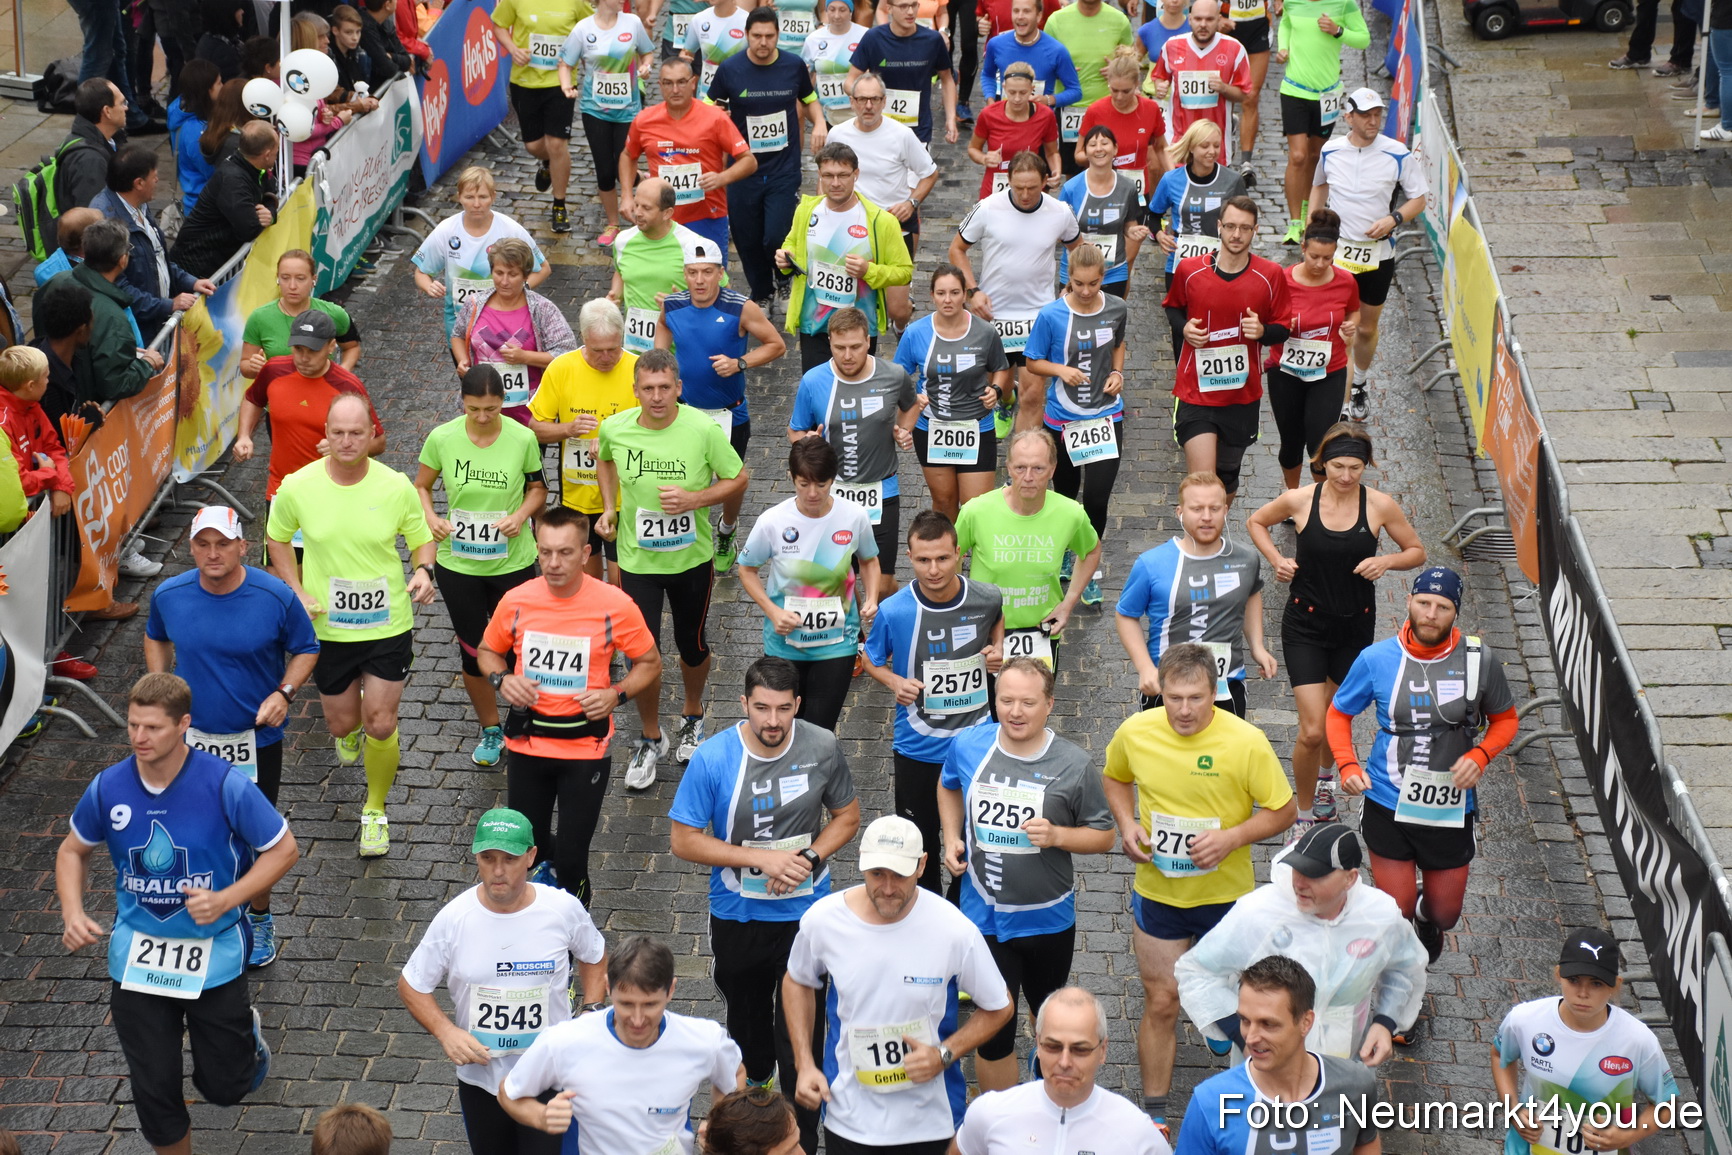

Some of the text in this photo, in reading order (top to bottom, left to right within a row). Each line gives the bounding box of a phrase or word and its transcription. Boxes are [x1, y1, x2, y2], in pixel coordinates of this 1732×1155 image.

[783, 19, 810, 33] 2857
[463, 25, 497, 88] Hervis
[533, 42, 562, 57] 205
[596, 81, 628, 96] 2053
[423, 78, 447, 146] Hervis
[891, 99, 907, 114] 42
[752, 121, 785, 139] 2294
[760, 140, 780, 148] Roman
[1343, 245, 1372, 263] 275
[816, 271, 854, 293] 2638
[824, 292, 841, 302] Peter
[1202, 354, 1245, 376] 2018
[1286, 348, 1327, 367] 2373
[1209, 376, 1241, 386] Christian
[569, 407, 598, 415] Norbert
[840, 397, 859, 477] HIMATEC
[933, 428, 976, 448] 2606
[1069, 425, 1112, 449] 2468
[943, 449, 964, 460] Jenny
[455, 521, 501, 542] 2147
[642, 515, 691, 538] 2149
[460, 543, 497, 554] Katharina
[652, 538, 683, 548] Michael
[993, 534, 1055, 548] NOVINA
[993, 550, 1054, 563] HOTELS
[334, 589, 385, 611] 3032
[800, 633, 829, 642] Monika
[528, 647, 583, 673] 2474
[931, 668, 983, 695] 2579
[943, 697, 972, 708] Michal
[1407, 782, 1462, 805] 3039
[109, 803, 132, 832] 9
[977, 799, 1036, 829] 2252
[988, 832, 1019, 845] Daniel
[1171, 860, 1196, 871] Hans
[141, 896, 182, 905] BASKETS
[136, 938, 204, 972] 2118
[516, 960, 554, 971] BÜSCHEL
[146, 972, 183, 988] Roland
[506, 987, 543, 1000] BOCK
[477, 1002, 543, 1031] 2543
[498, 1037, 519, 1049] Udo
[1531, 1056, 1553, 1069] PARTL
[1531, 1062, 1553, 1074] Neumarkt
[1603, 1060, 1630, 1071] Hervis
